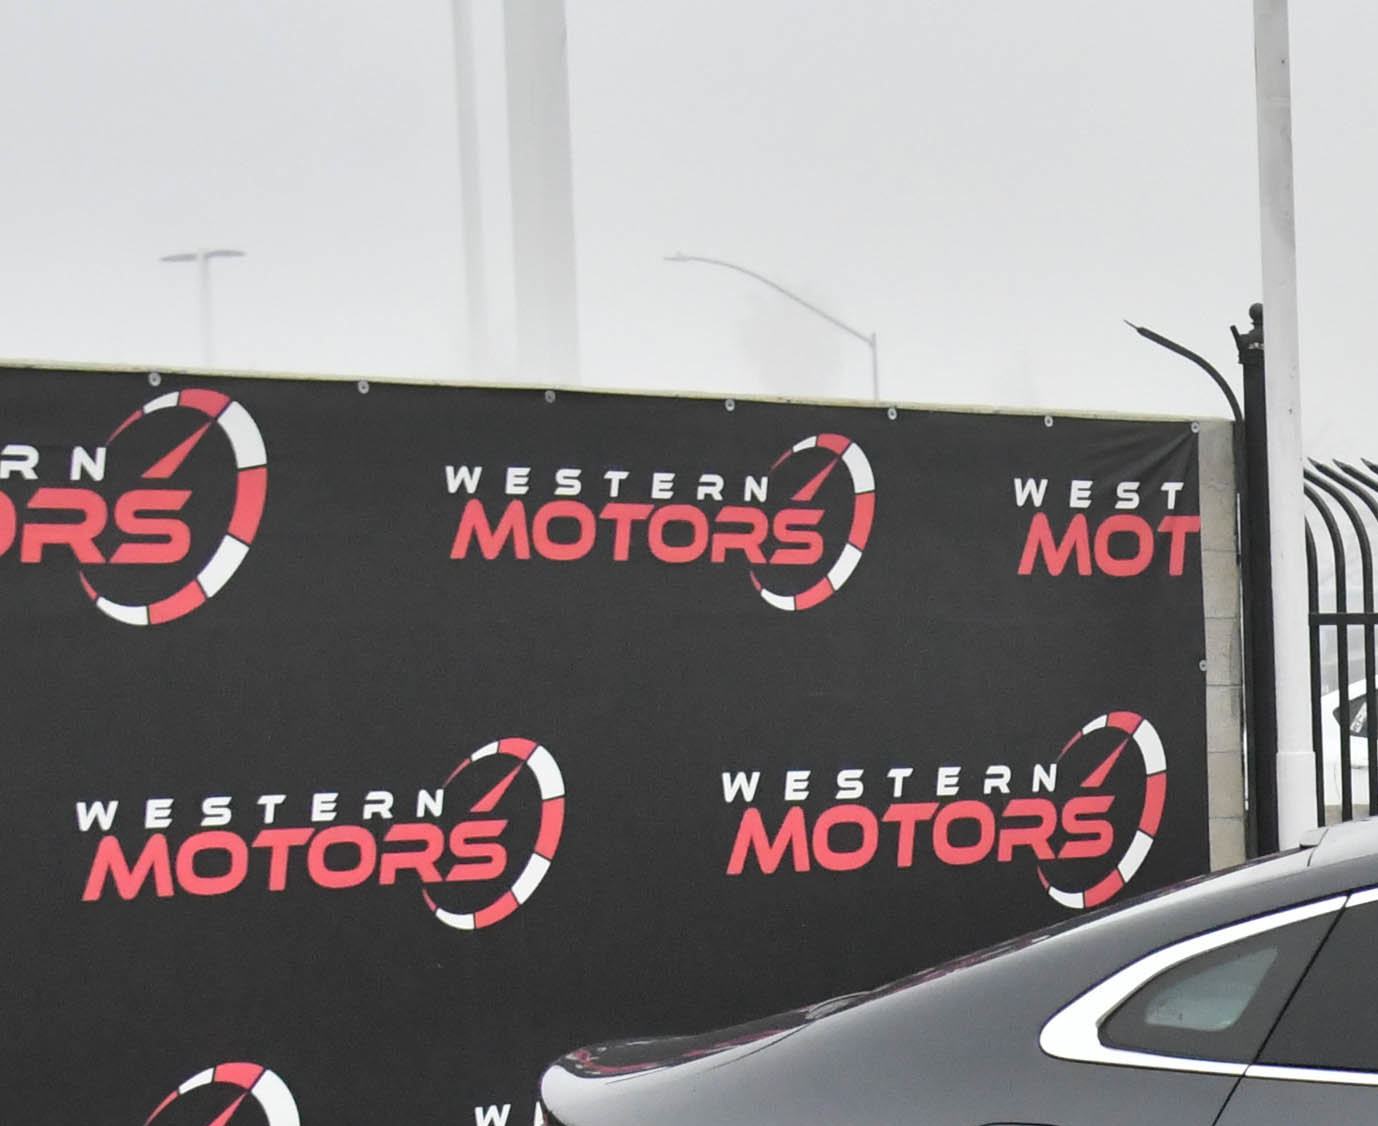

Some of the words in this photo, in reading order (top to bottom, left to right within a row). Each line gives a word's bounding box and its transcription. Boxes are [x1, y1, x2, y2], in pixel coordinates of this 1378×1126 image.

[445, 465, 769, 503] WESTERN
[1013, 477, 1184, 510] WEST
[0, 487, 193, 564] RS
[450, 498, 825, 565] MOTORS
[1017, 511, 1201, 577] MOT
[76, 788, 444, 832] WESTERN
[722, 763, 1057, 803] WESTERN
[82, 819, 508, 902] MOTORS
[726, 795, 1115, 876] MOTORS
